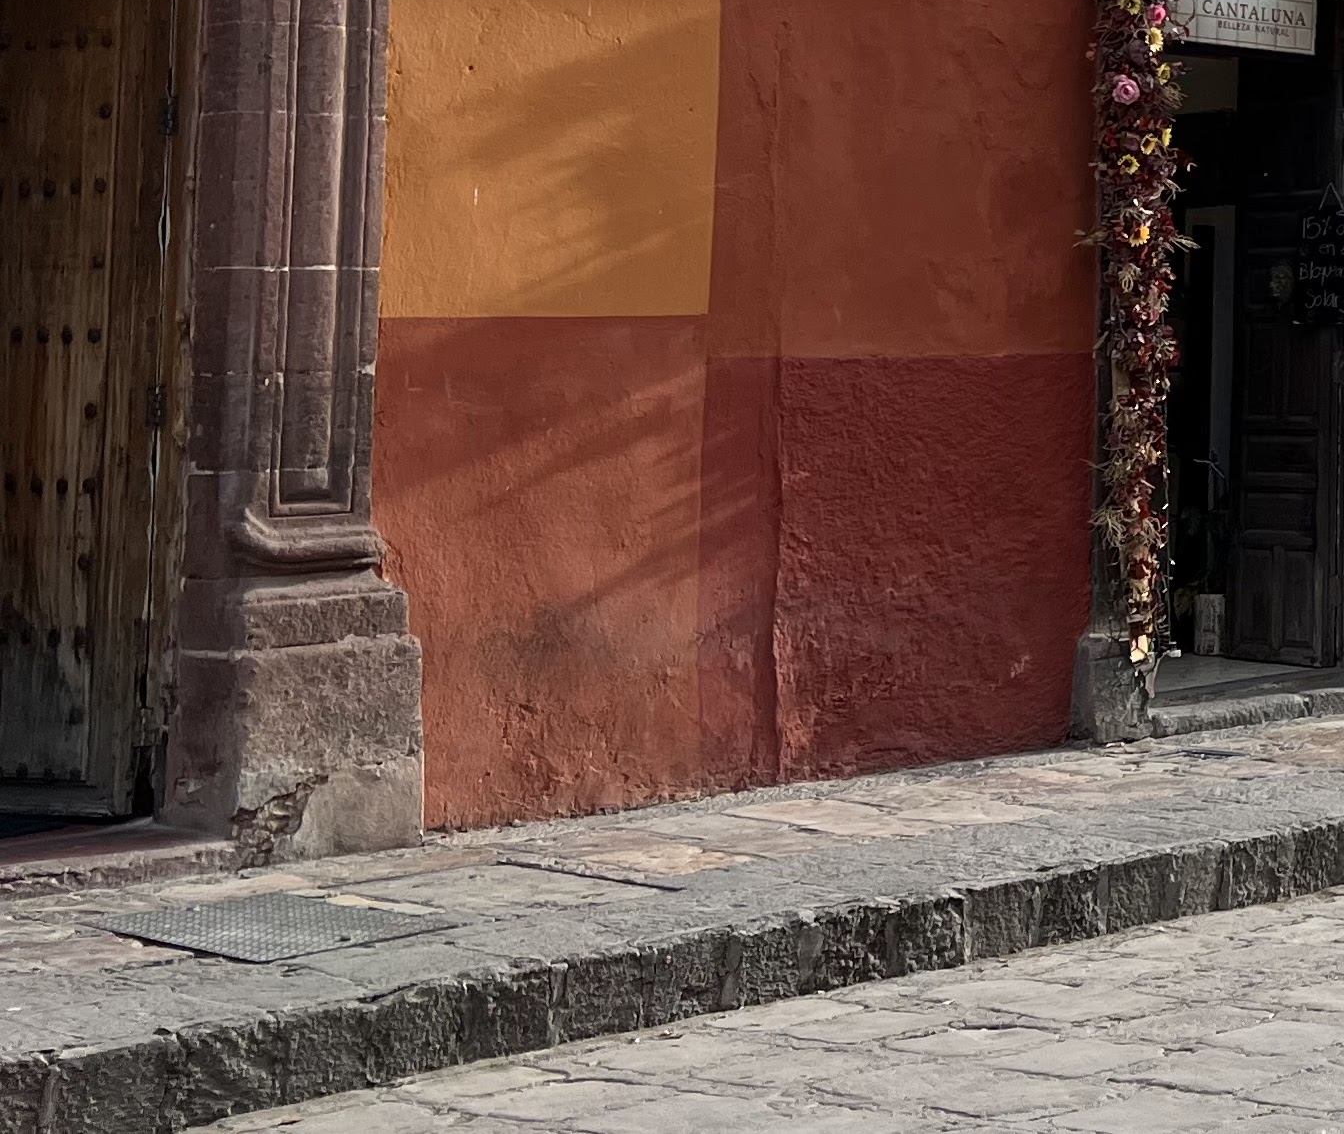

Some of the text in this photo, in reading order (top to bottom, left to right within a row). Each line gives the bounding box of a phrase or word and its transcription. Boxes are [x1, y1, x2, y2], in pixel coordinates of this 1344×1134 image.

[1202, 0, 1306, 26] CANTALUNA
[1217, 19, 1290, 37] BELLEZA NATURAL
[1302, 216, 1332, 239] 15%
[1319, 243, 1336, 256] en
[1305, 288, 1340, 309] Solar
